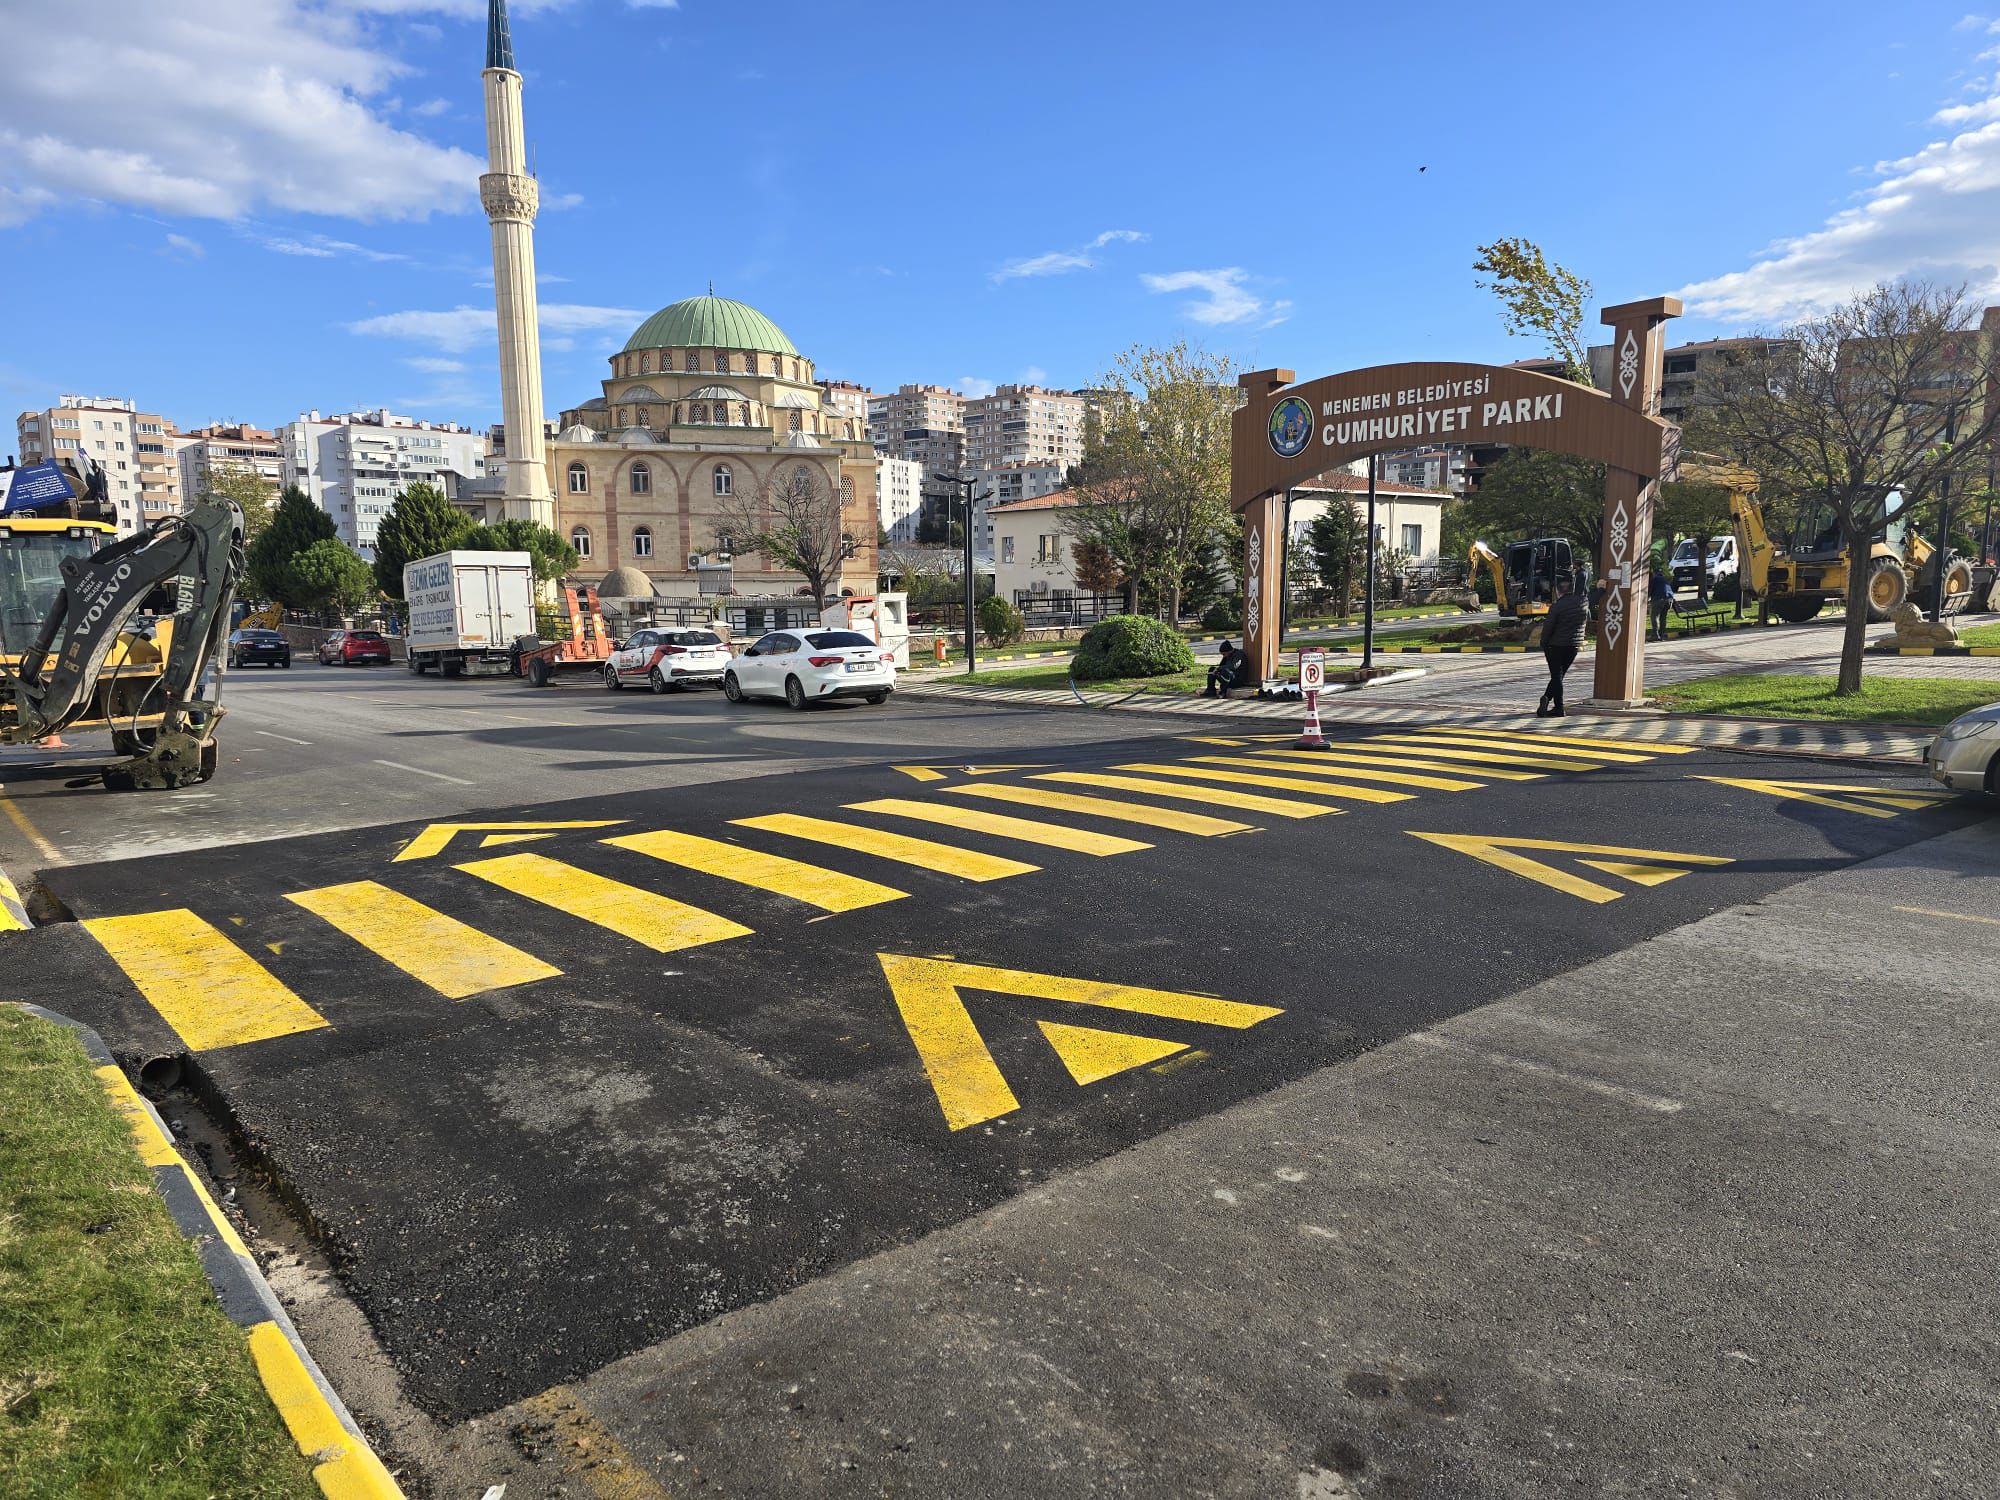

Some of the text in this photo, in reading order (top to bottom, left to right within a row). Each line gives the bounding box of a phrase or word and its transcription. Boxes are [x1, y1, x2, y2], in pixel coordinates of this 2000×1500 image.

[1323, 374, 1489, 416] MENEMEN BELEDİYESİ
[1322, 393, 1563, 446] CUMHURİYET PARKI
[428, 561, 450, 588] GEZER
[74, 563, 131, 635] VOLVO
